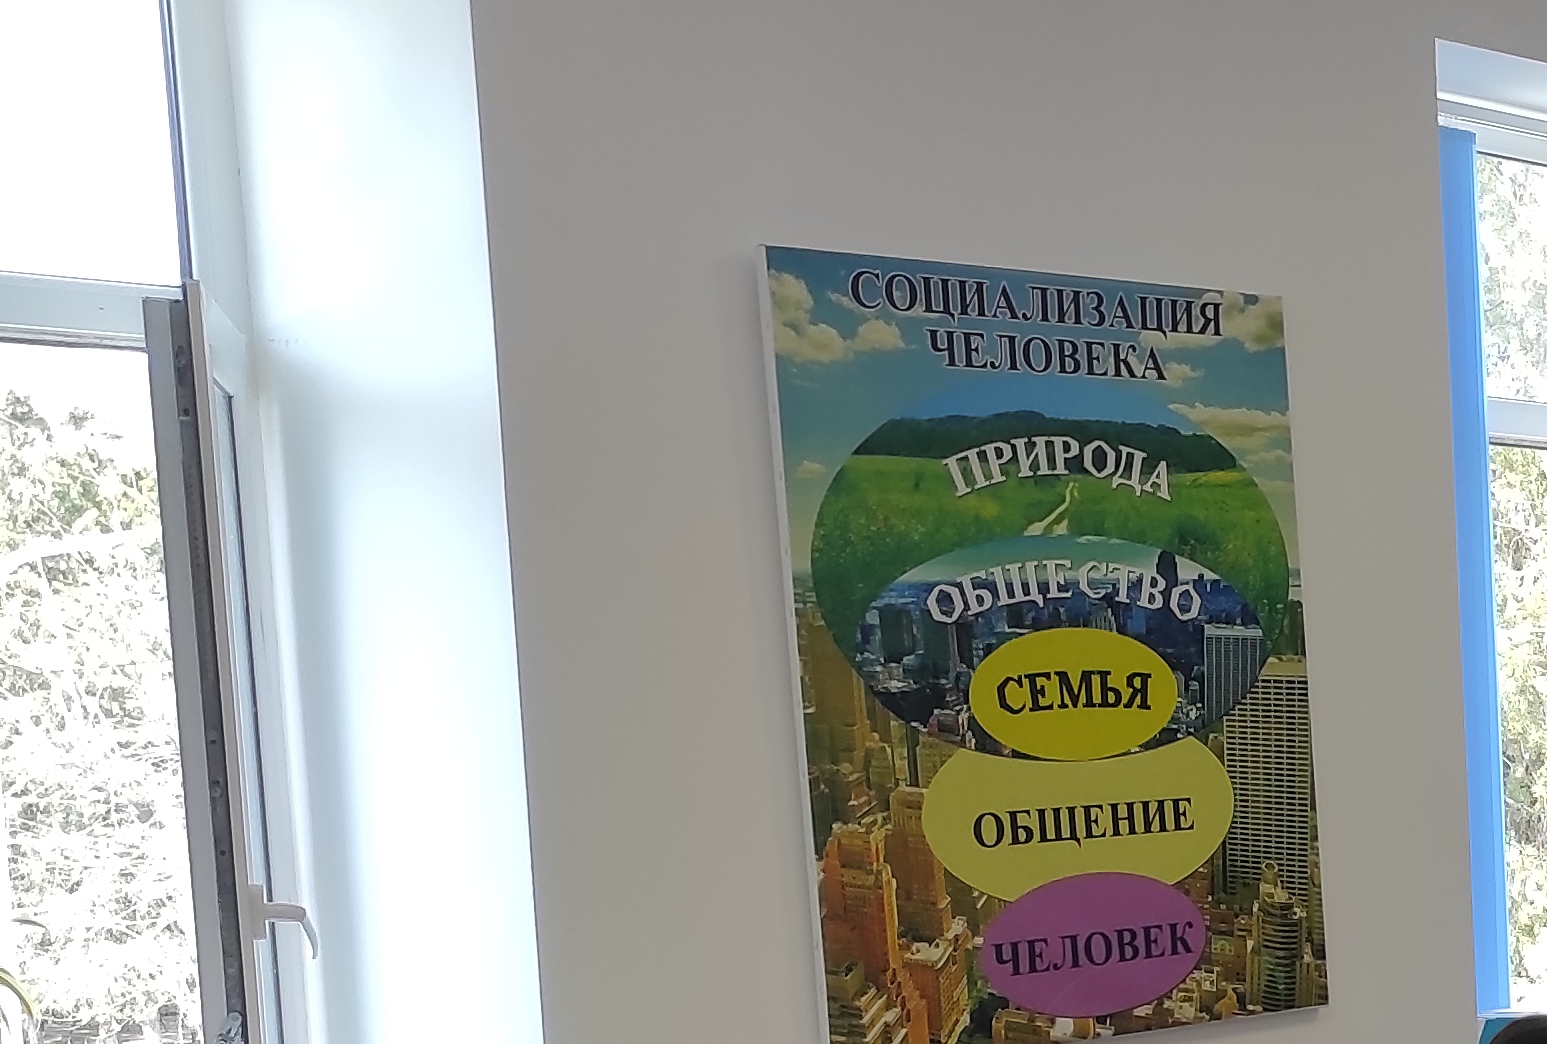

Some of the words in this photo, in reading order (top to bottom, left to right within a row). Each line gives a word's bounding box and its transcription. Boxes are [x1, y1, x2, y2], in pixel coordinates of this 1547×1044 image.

[848, 269, 1224, 338] СОЦИАЛИЗАЦИЯ
[925, 326, 1168, 382] ЧЕЛОВЕКА
[941, 434, 1172, 502] ПРИРОДА
[925, 558, 1203, 625] ОБЩЕСТВО
[995, 669, 1153, 716] СЕМЬЯ
[972, 796, 1195, 850] ОБЩЕНИЕ
[991, 920, 1195, 978] ЧЕЛОВЕК
